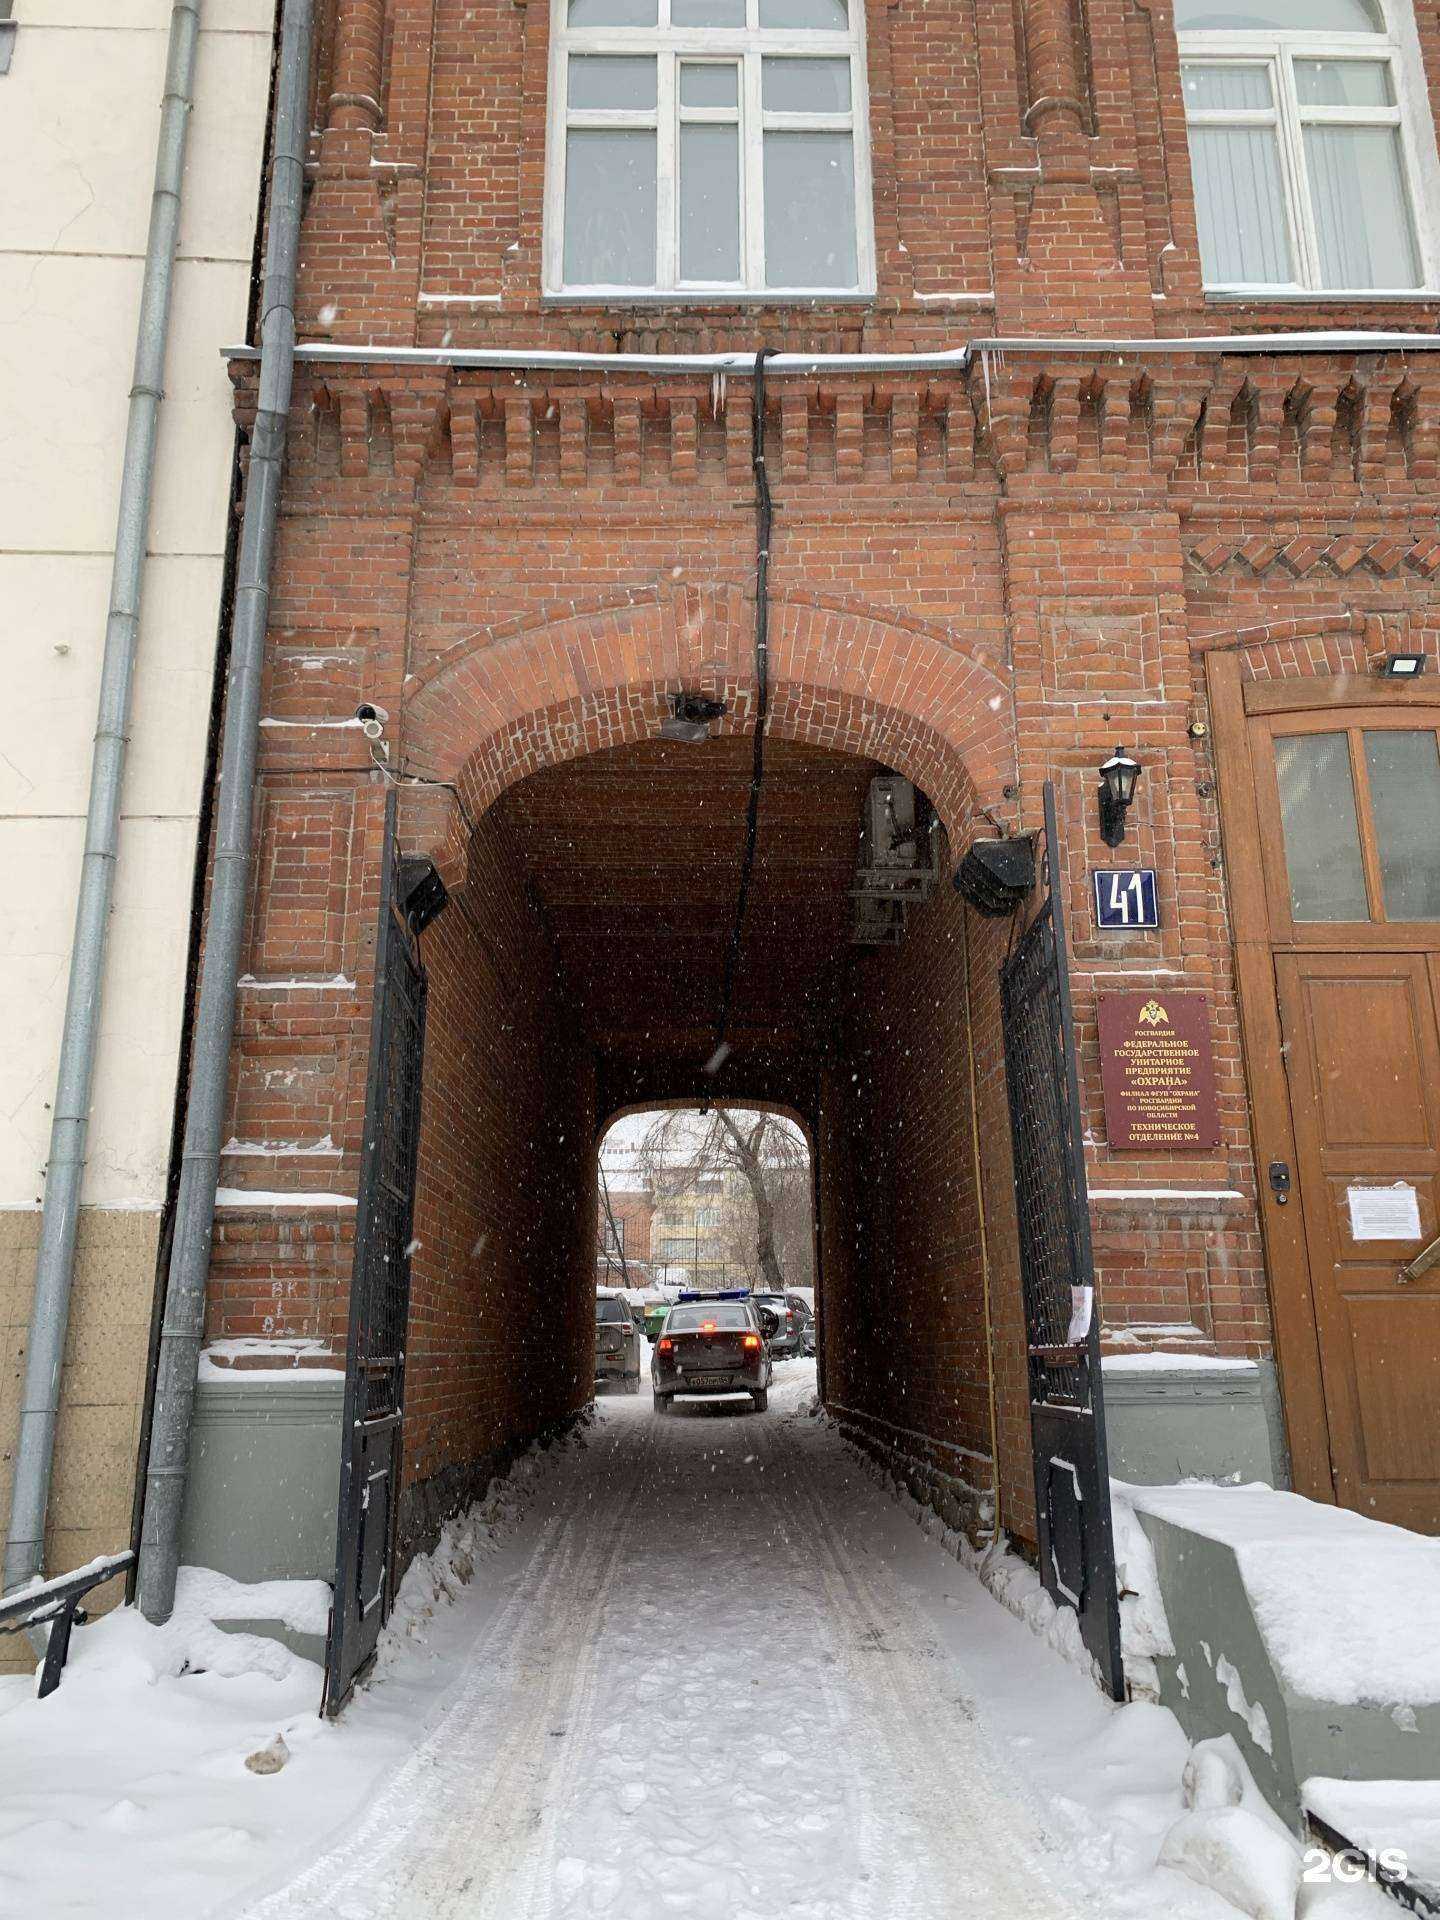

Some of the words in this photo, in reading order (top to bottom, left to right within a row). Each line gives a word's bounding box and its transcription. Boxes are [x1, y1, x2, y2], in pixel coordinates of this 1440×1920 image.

[1110, 874, 1144, 923] 41
[1123, 1040, 1189, 1048] ФЕДЕРАЛЬНОЕ
[1114, 1049, 1200, 1057] ГОСУДАРСТВЕННОЕ
[1130, 1058, 1184, 1066] УНИТАРНОЕ
[1125, 1067, 1192, 1075] ПРЕДПРИЯТИЕ
[1130, 1076, 1188, 1086] «ОХРАНА»
[1130, 1123, 1196, 1131] ТЕХНИЧЕСКОЕ
[1129, 1133, 1183, 1142] ОТДЕЛЕНИЕ
[1184, 1133, 1200, 1141] №4
